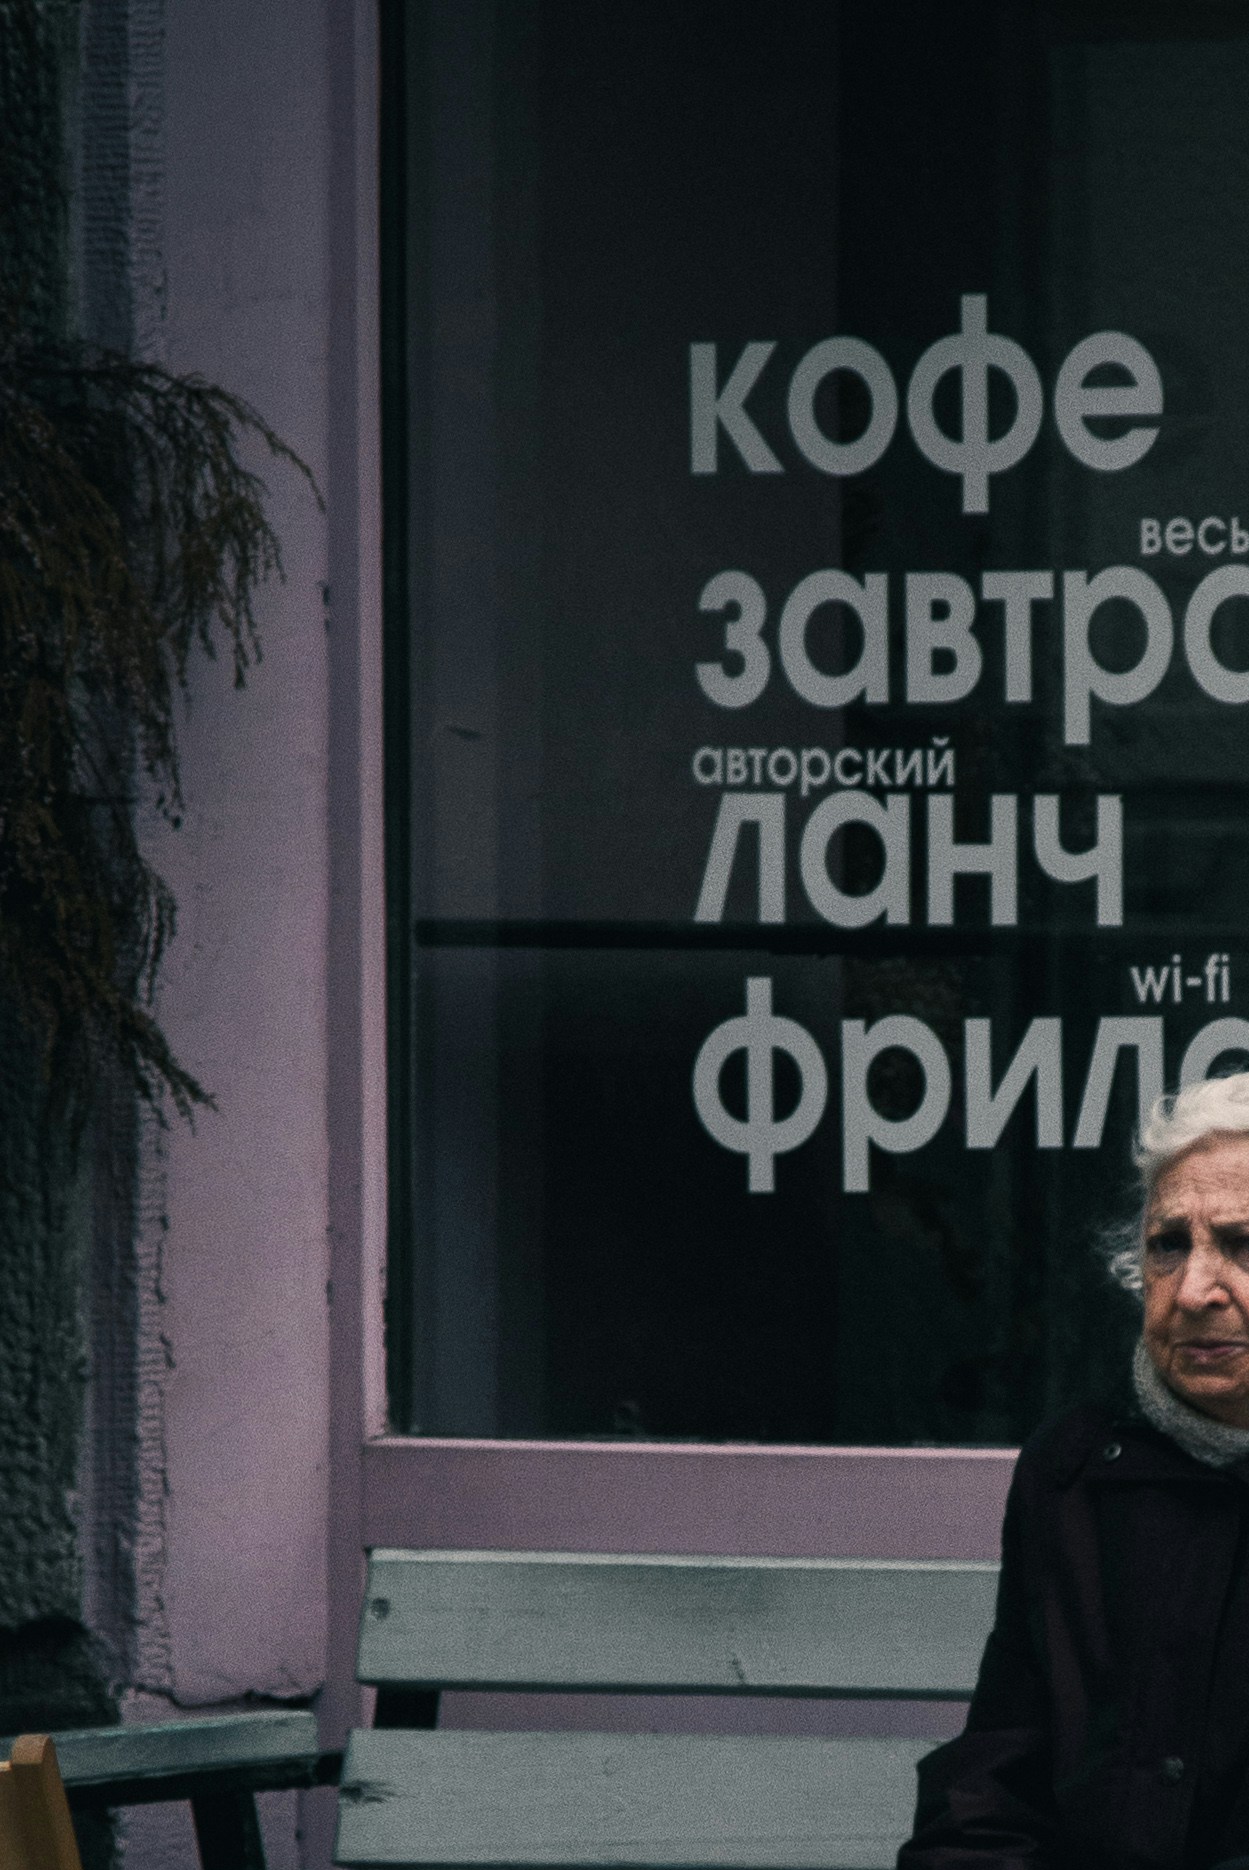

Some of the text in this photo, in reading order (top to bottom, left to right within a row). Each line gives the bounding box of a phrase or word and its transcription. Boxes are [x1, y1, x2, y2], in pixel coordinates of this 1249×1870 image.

[689, 292, 1164, 514] кофе
[692, 738, 955, 797] авторский
[693, 790, 1125, 928] ланч
[1130, 953, 1231, 1003] wi-fi
